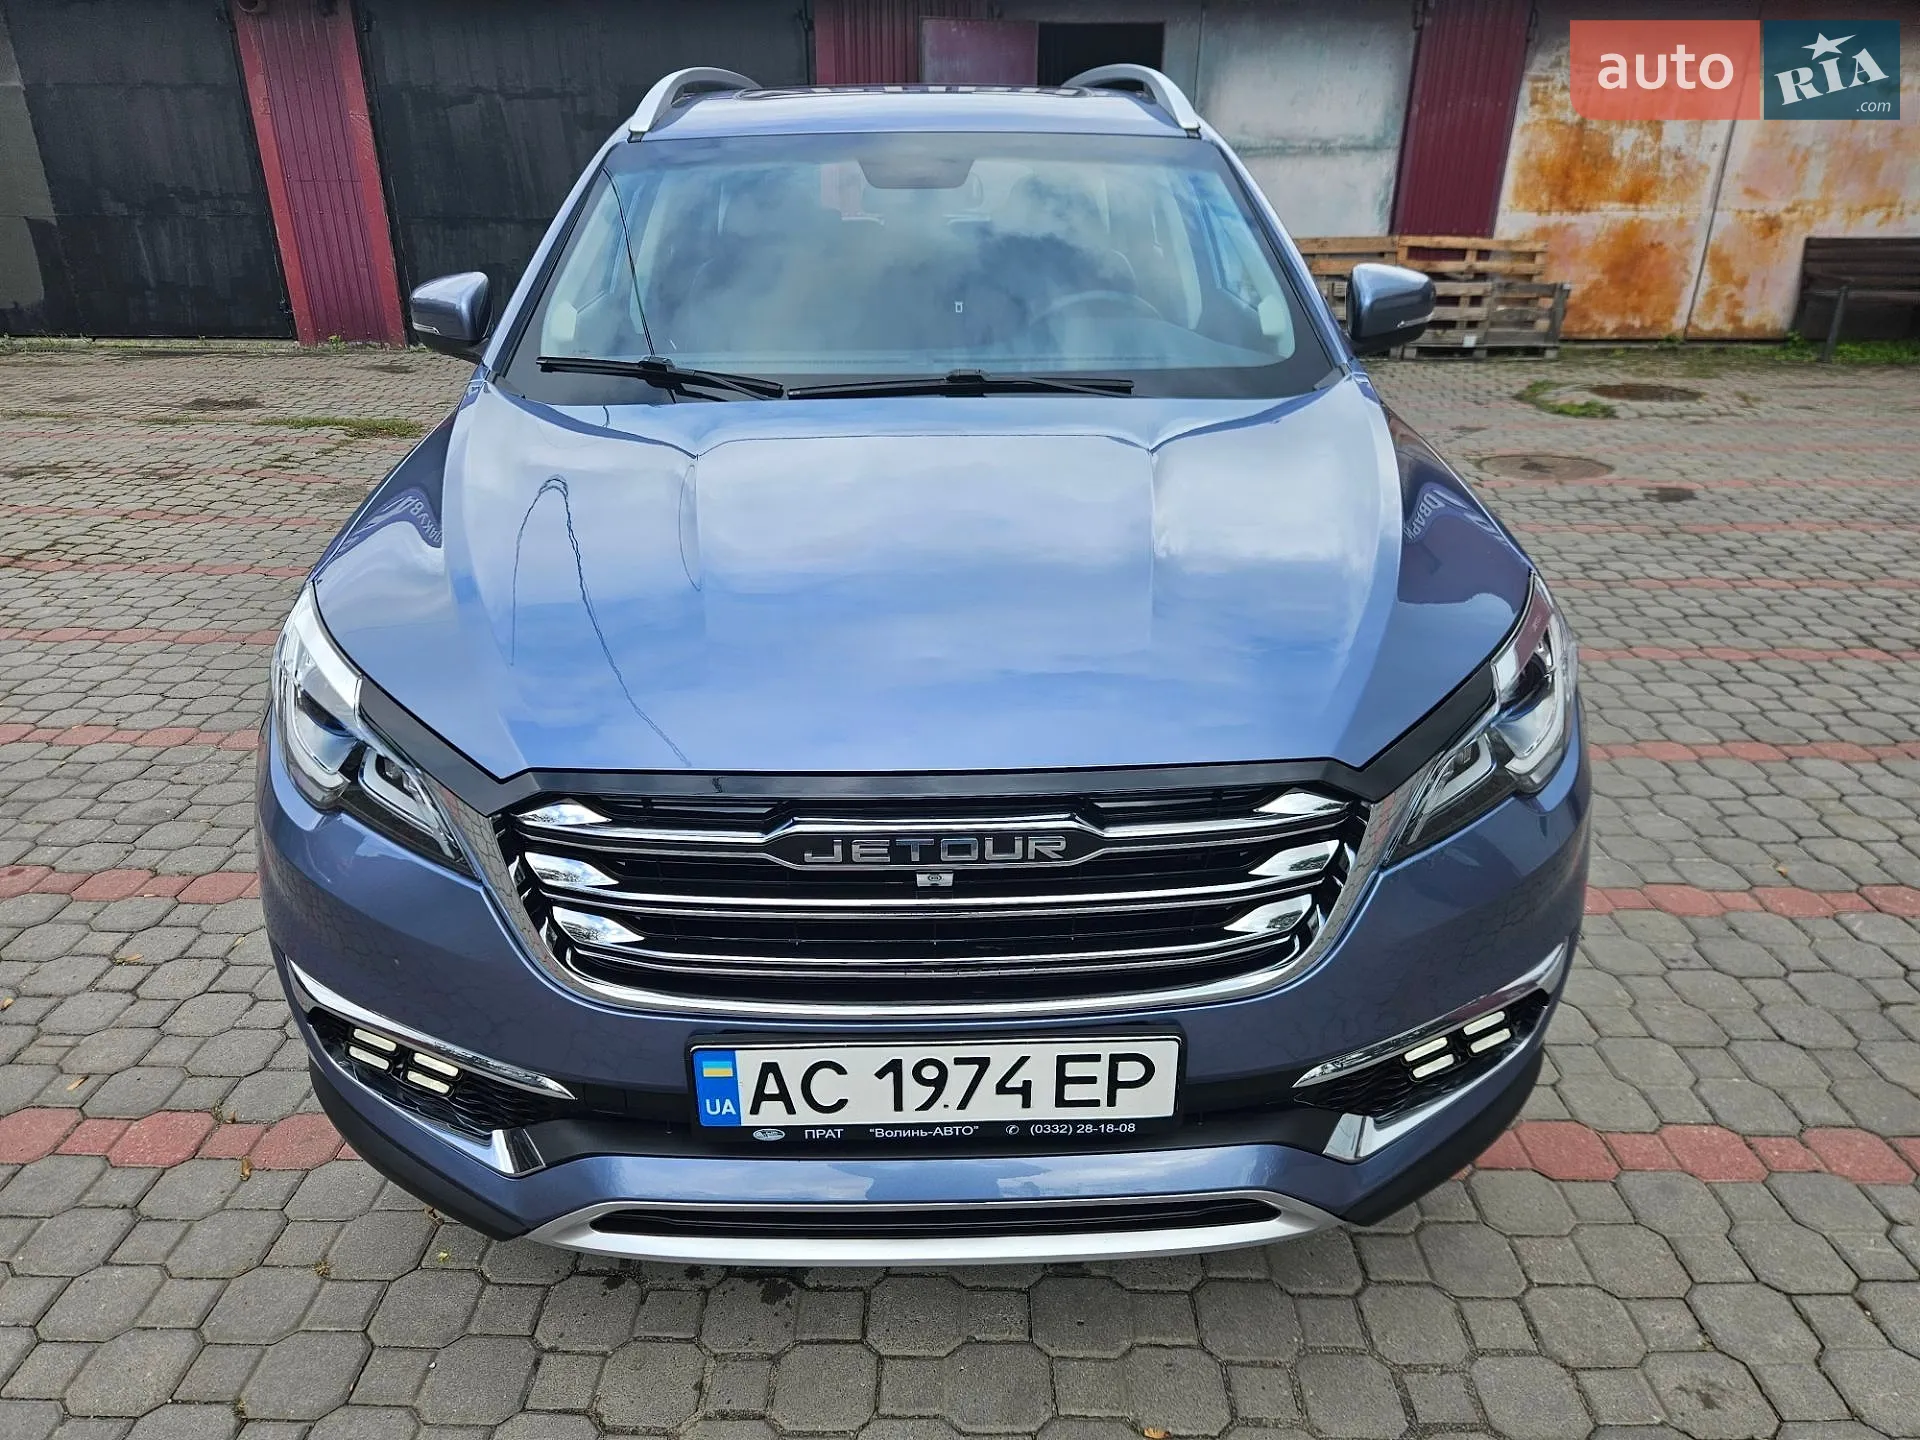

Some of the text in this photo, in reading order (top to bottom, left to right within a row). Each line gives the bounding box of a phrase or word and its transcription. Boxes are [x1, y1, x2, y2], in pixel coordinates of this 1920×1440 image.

[804, 835, 1067, 863] JETOUR
[749, 1052, 1156, 1115] AC 1974 EP
[705, 1098, 737, 1116] UA
[804, 1128, 845, 1140] ПРАТ
[1030, 1123, 1073, 1136] (0332)
[1076, 1122, 1137, 1134] 28-18-08
